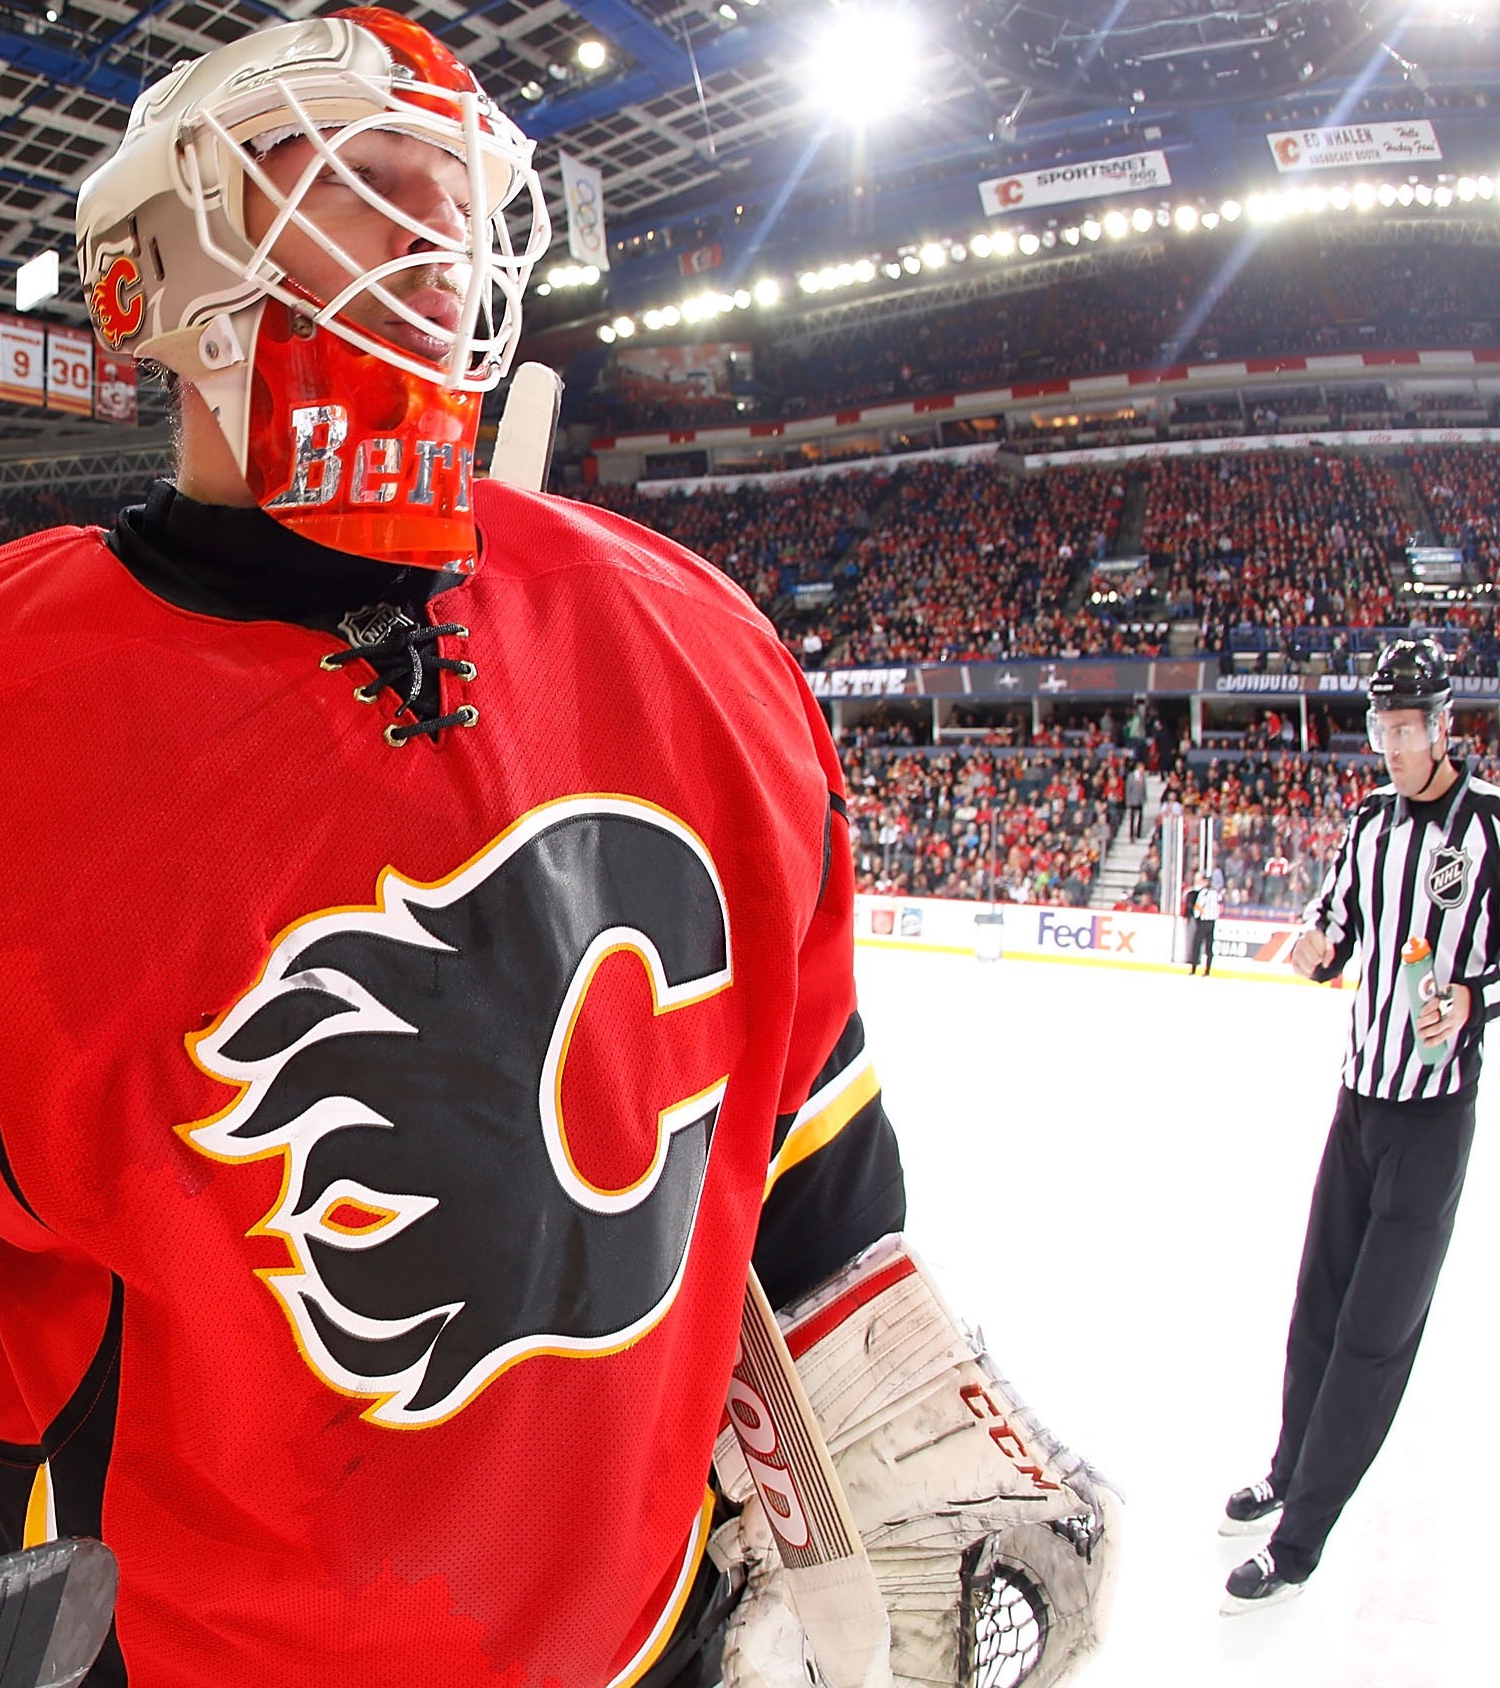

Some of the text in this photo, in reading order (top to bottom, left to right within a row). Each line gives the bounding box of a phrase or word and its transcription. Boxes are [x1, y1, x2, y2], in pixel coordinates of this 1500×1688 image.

[1303, 128, 1373, 148] ED WHALEN
[1037, 157, 1148, 186] SPORTSNET
[14, 350, 30, 378] 9
[52, 358, 89, 390] 30
[1433, 862, 1462, 891] NHL
[1038, 911, 1135, 954] FedEx
[958, 1382, 1062, 1491] CCM
[724, 1374, 812, 1551] OD
